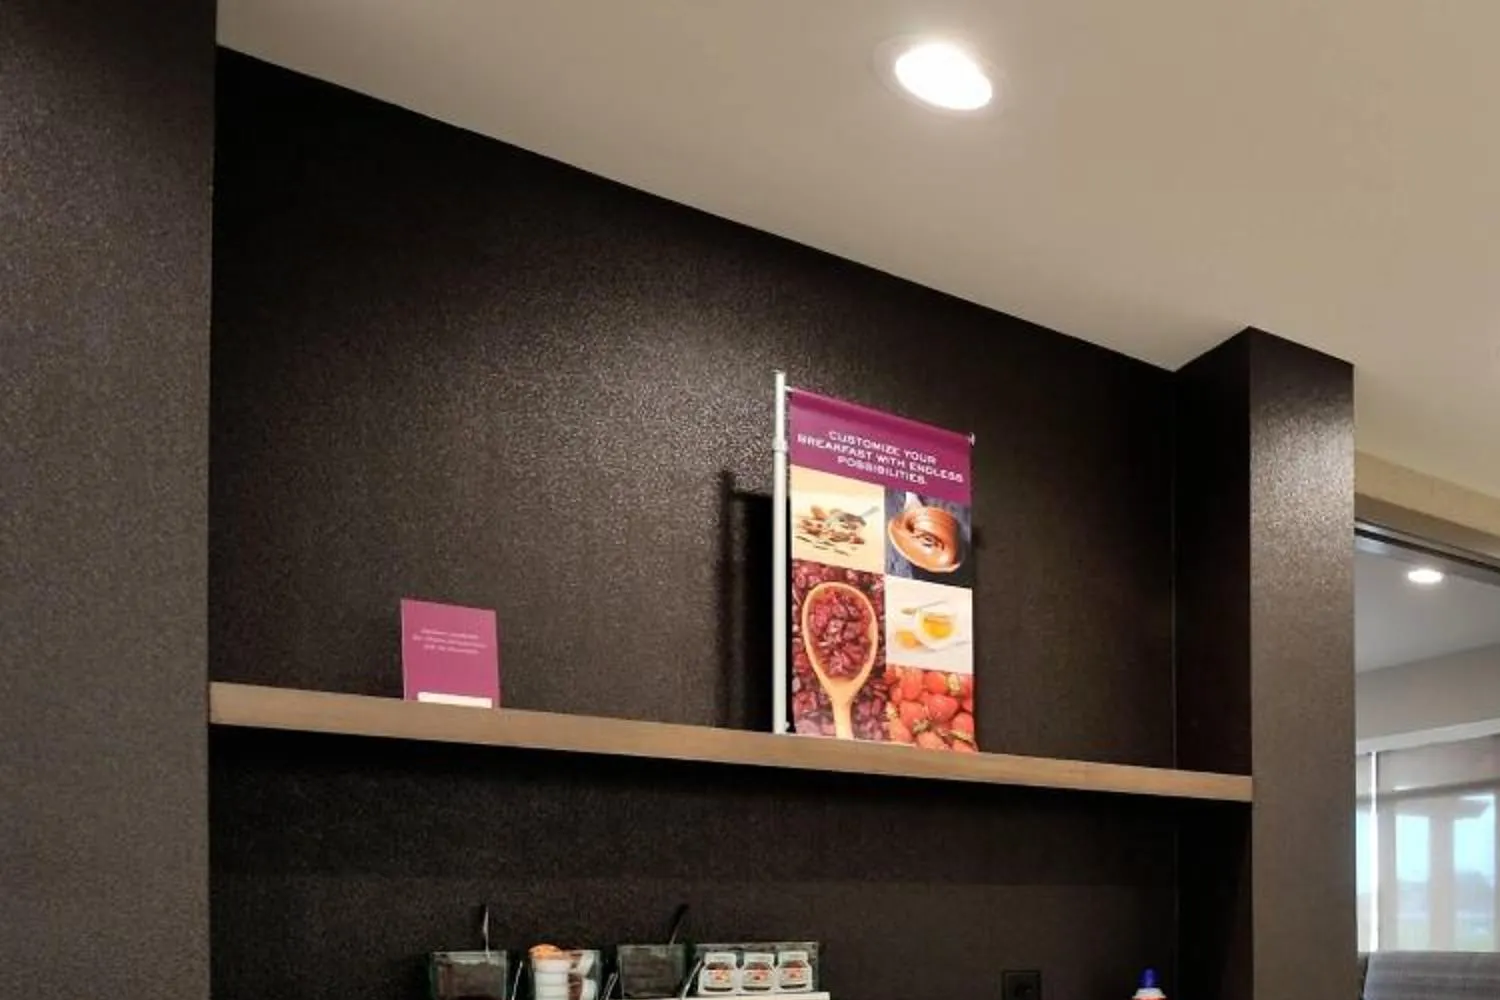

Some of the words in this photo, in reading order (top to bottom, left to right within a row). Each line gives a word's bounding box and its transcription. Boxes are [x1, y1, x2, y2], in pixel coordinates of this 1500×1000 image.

[797, 433, 872, 460] BREAKFAST
[876, 453, 906, 468] WITH
[909, 461, 964, 483] ENDLESS
[828, 430, 899, 456] CUSTOMIZE
[903, 448, 937, 464] YOUR
